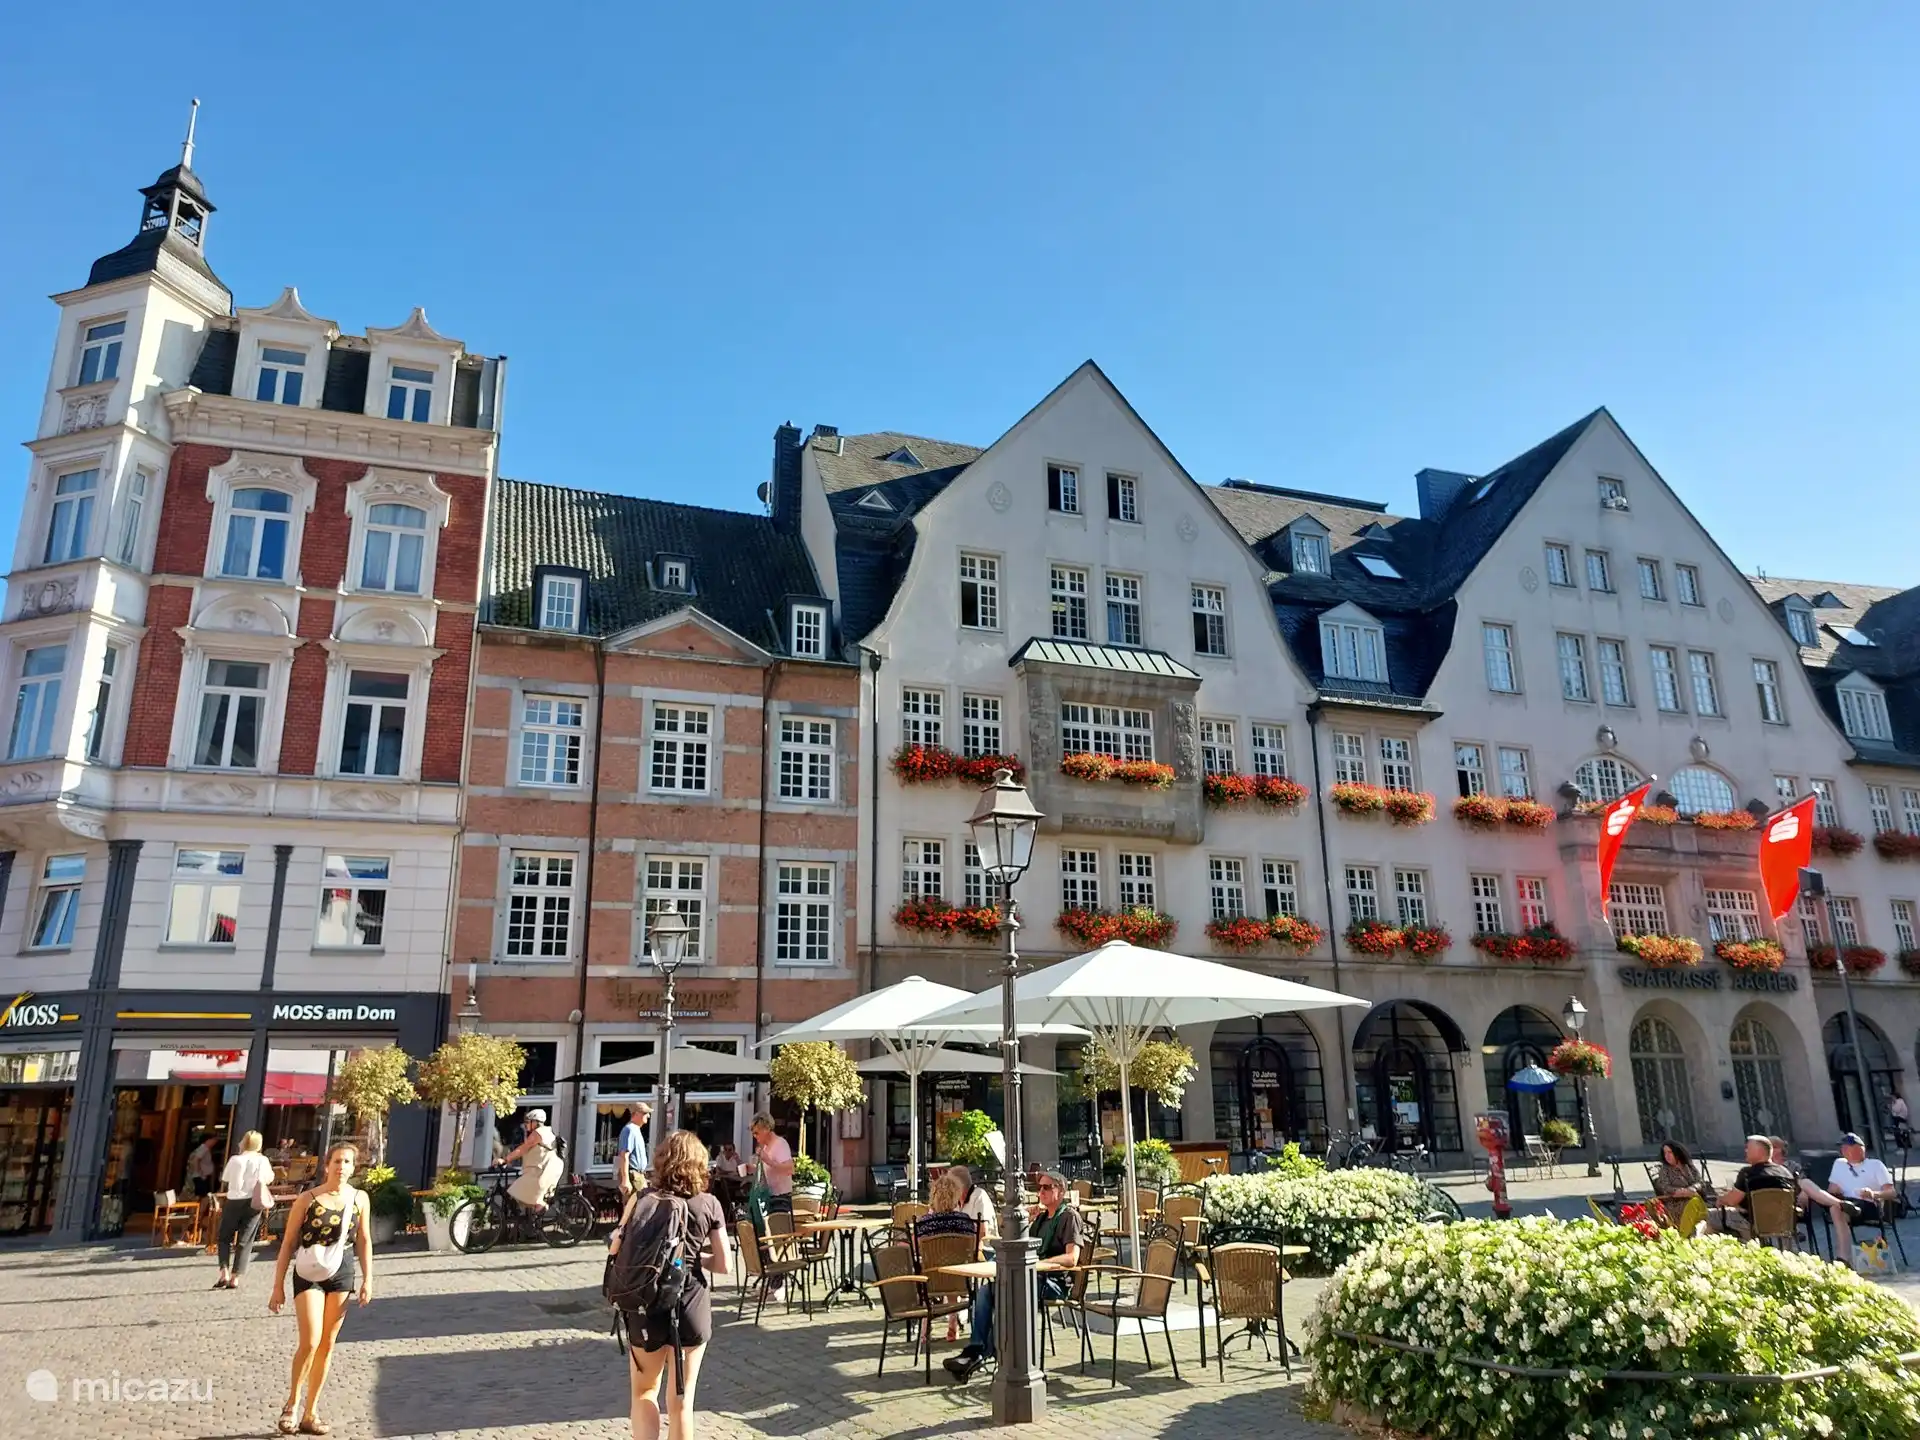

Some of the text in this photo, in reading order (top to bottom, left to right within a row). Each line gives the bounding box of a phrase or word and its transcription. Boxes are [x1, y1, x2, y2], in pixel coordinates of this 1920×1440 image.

[1734, 973, 1798, 991] AACHEN
[6, 1004, 59, 1027] MOSS
[272, 1004, 396, 1020] MOSS am Dom
